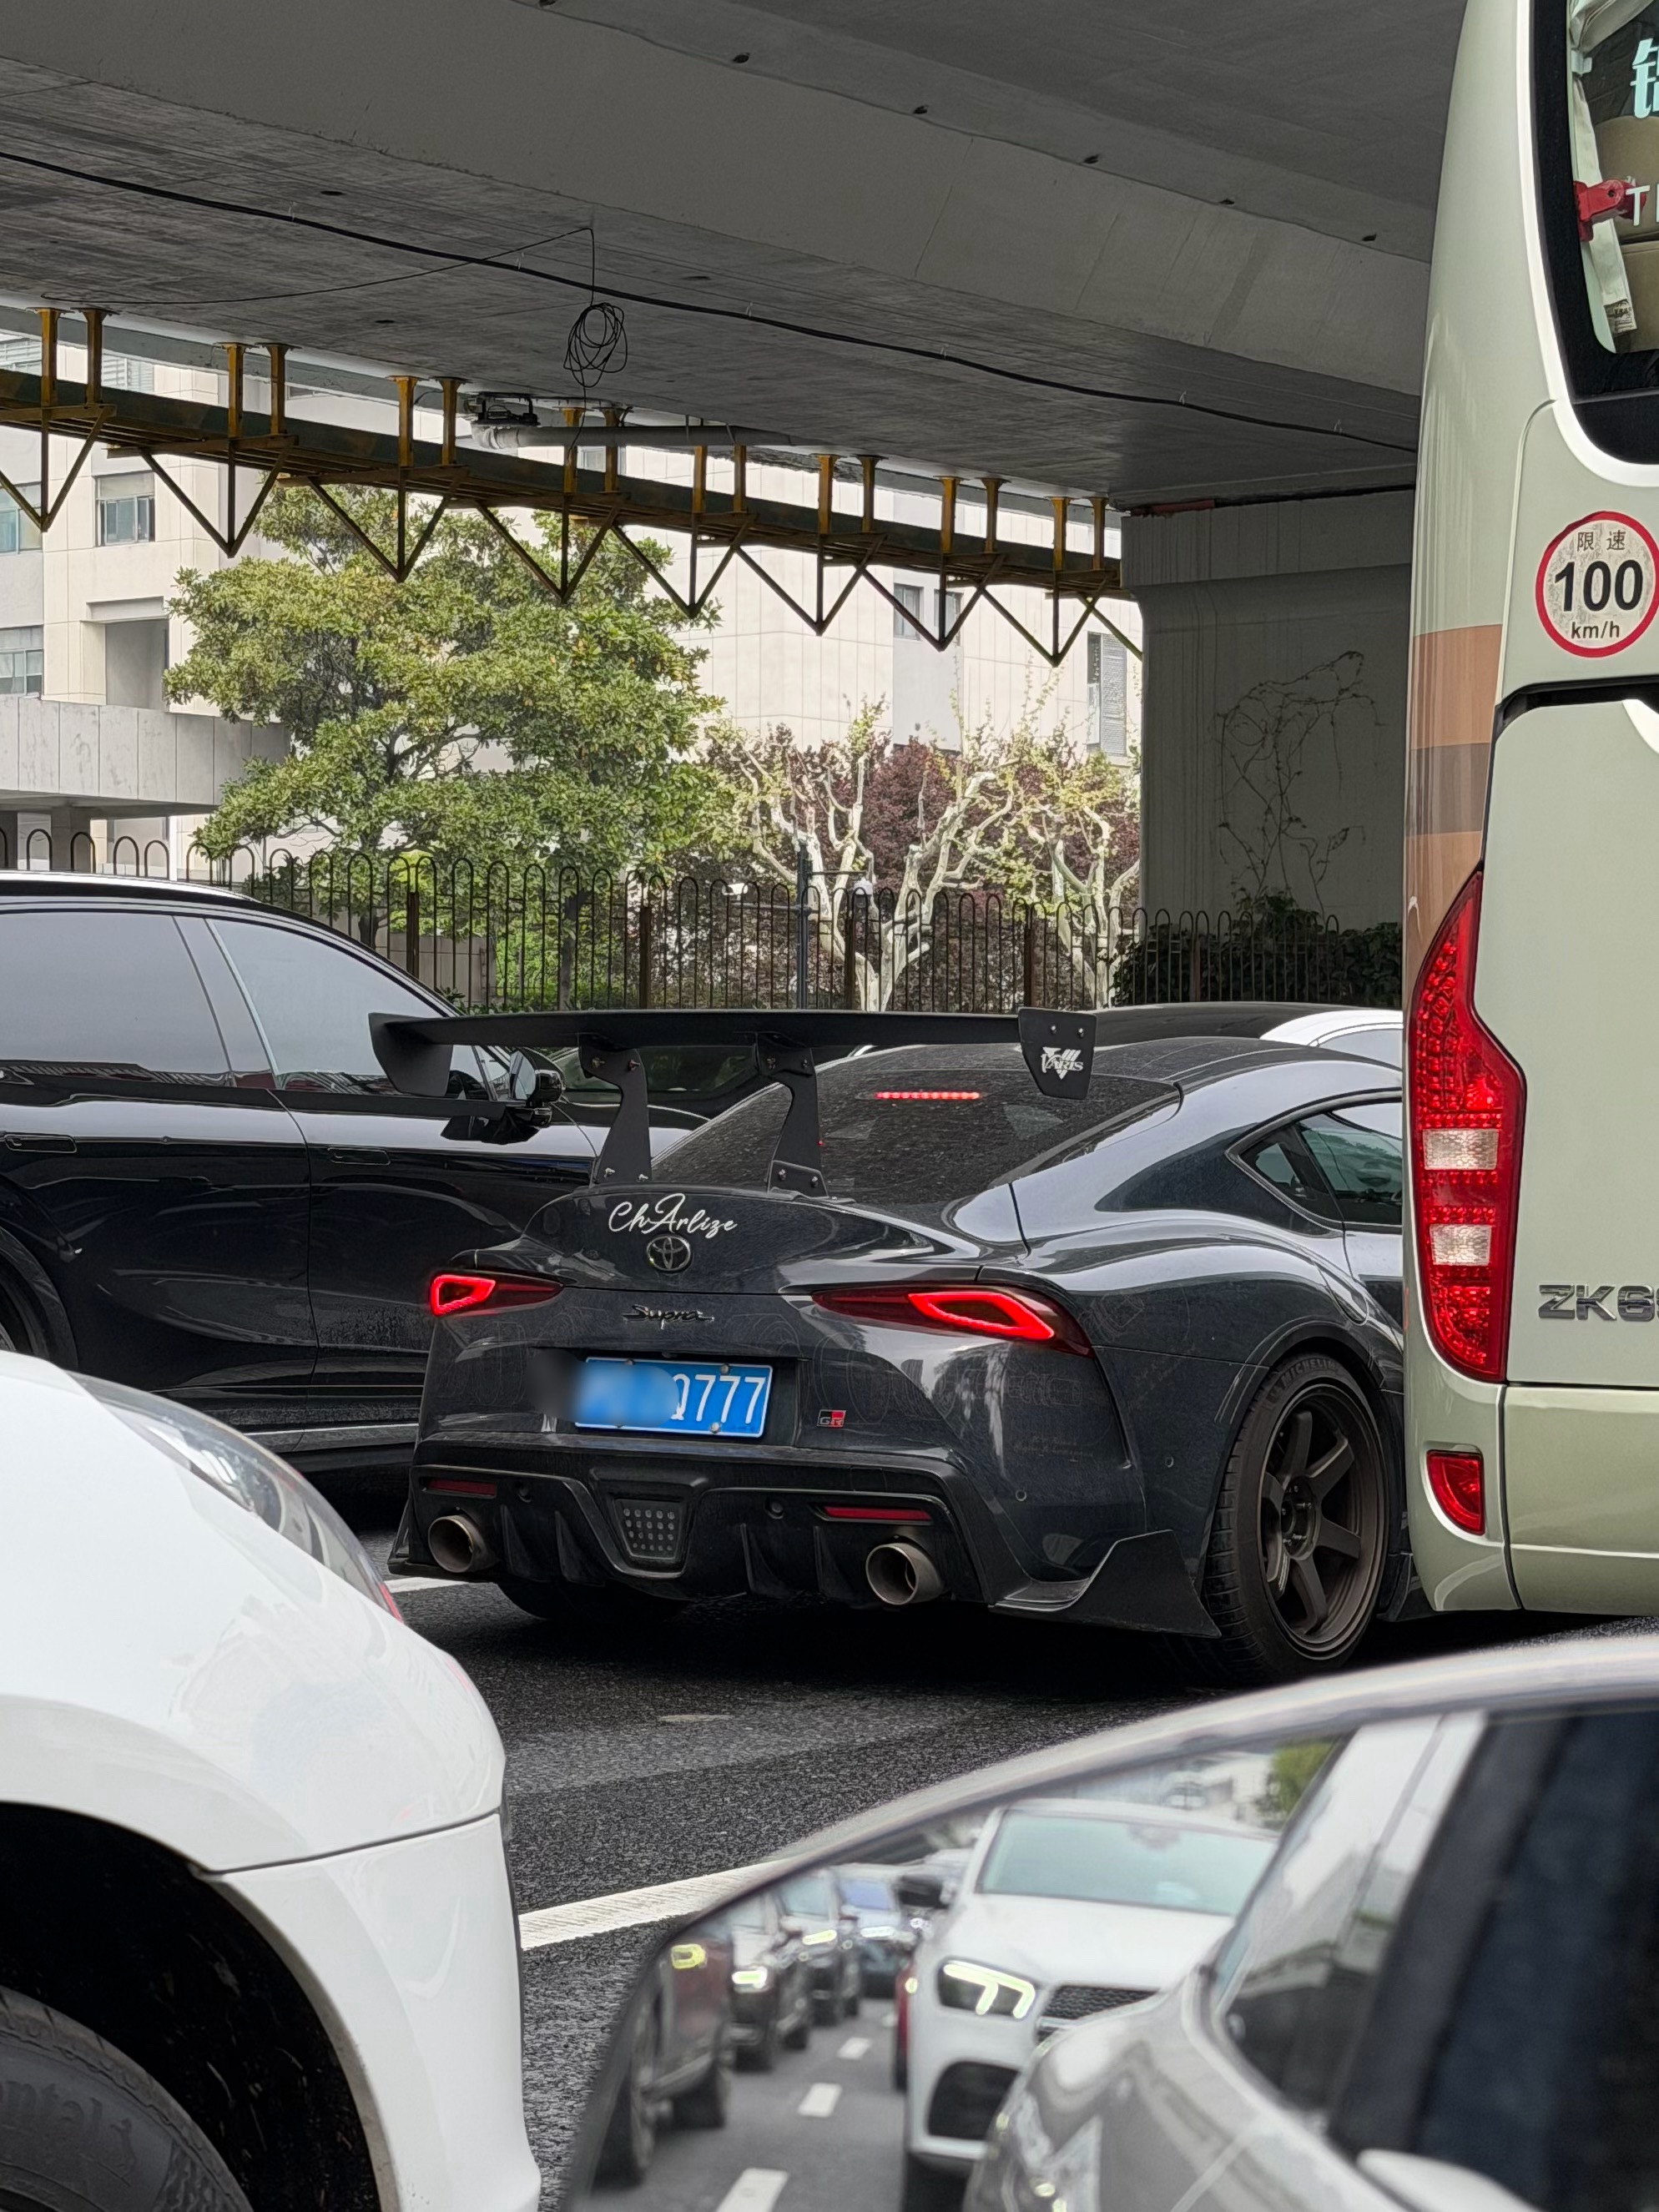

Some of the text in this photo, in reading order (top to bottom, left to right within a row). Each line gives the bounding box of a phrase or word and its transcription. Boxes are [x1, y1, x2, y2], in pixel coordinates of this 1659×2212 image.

[1576, 529, 1626, 552] 限速
[1554, 559, 1643, 612] 100
[1571, 621, 1620, 639] km/h
[1538, 1283, 1659, 1322] ZK6
[622, 1304, 715, 1330] Supra
[1280, 1357, 1337, 1387] MICHELIN
[670, 1373, 767, 1424] Q777
[819, 1414, 845, 1426] GR
